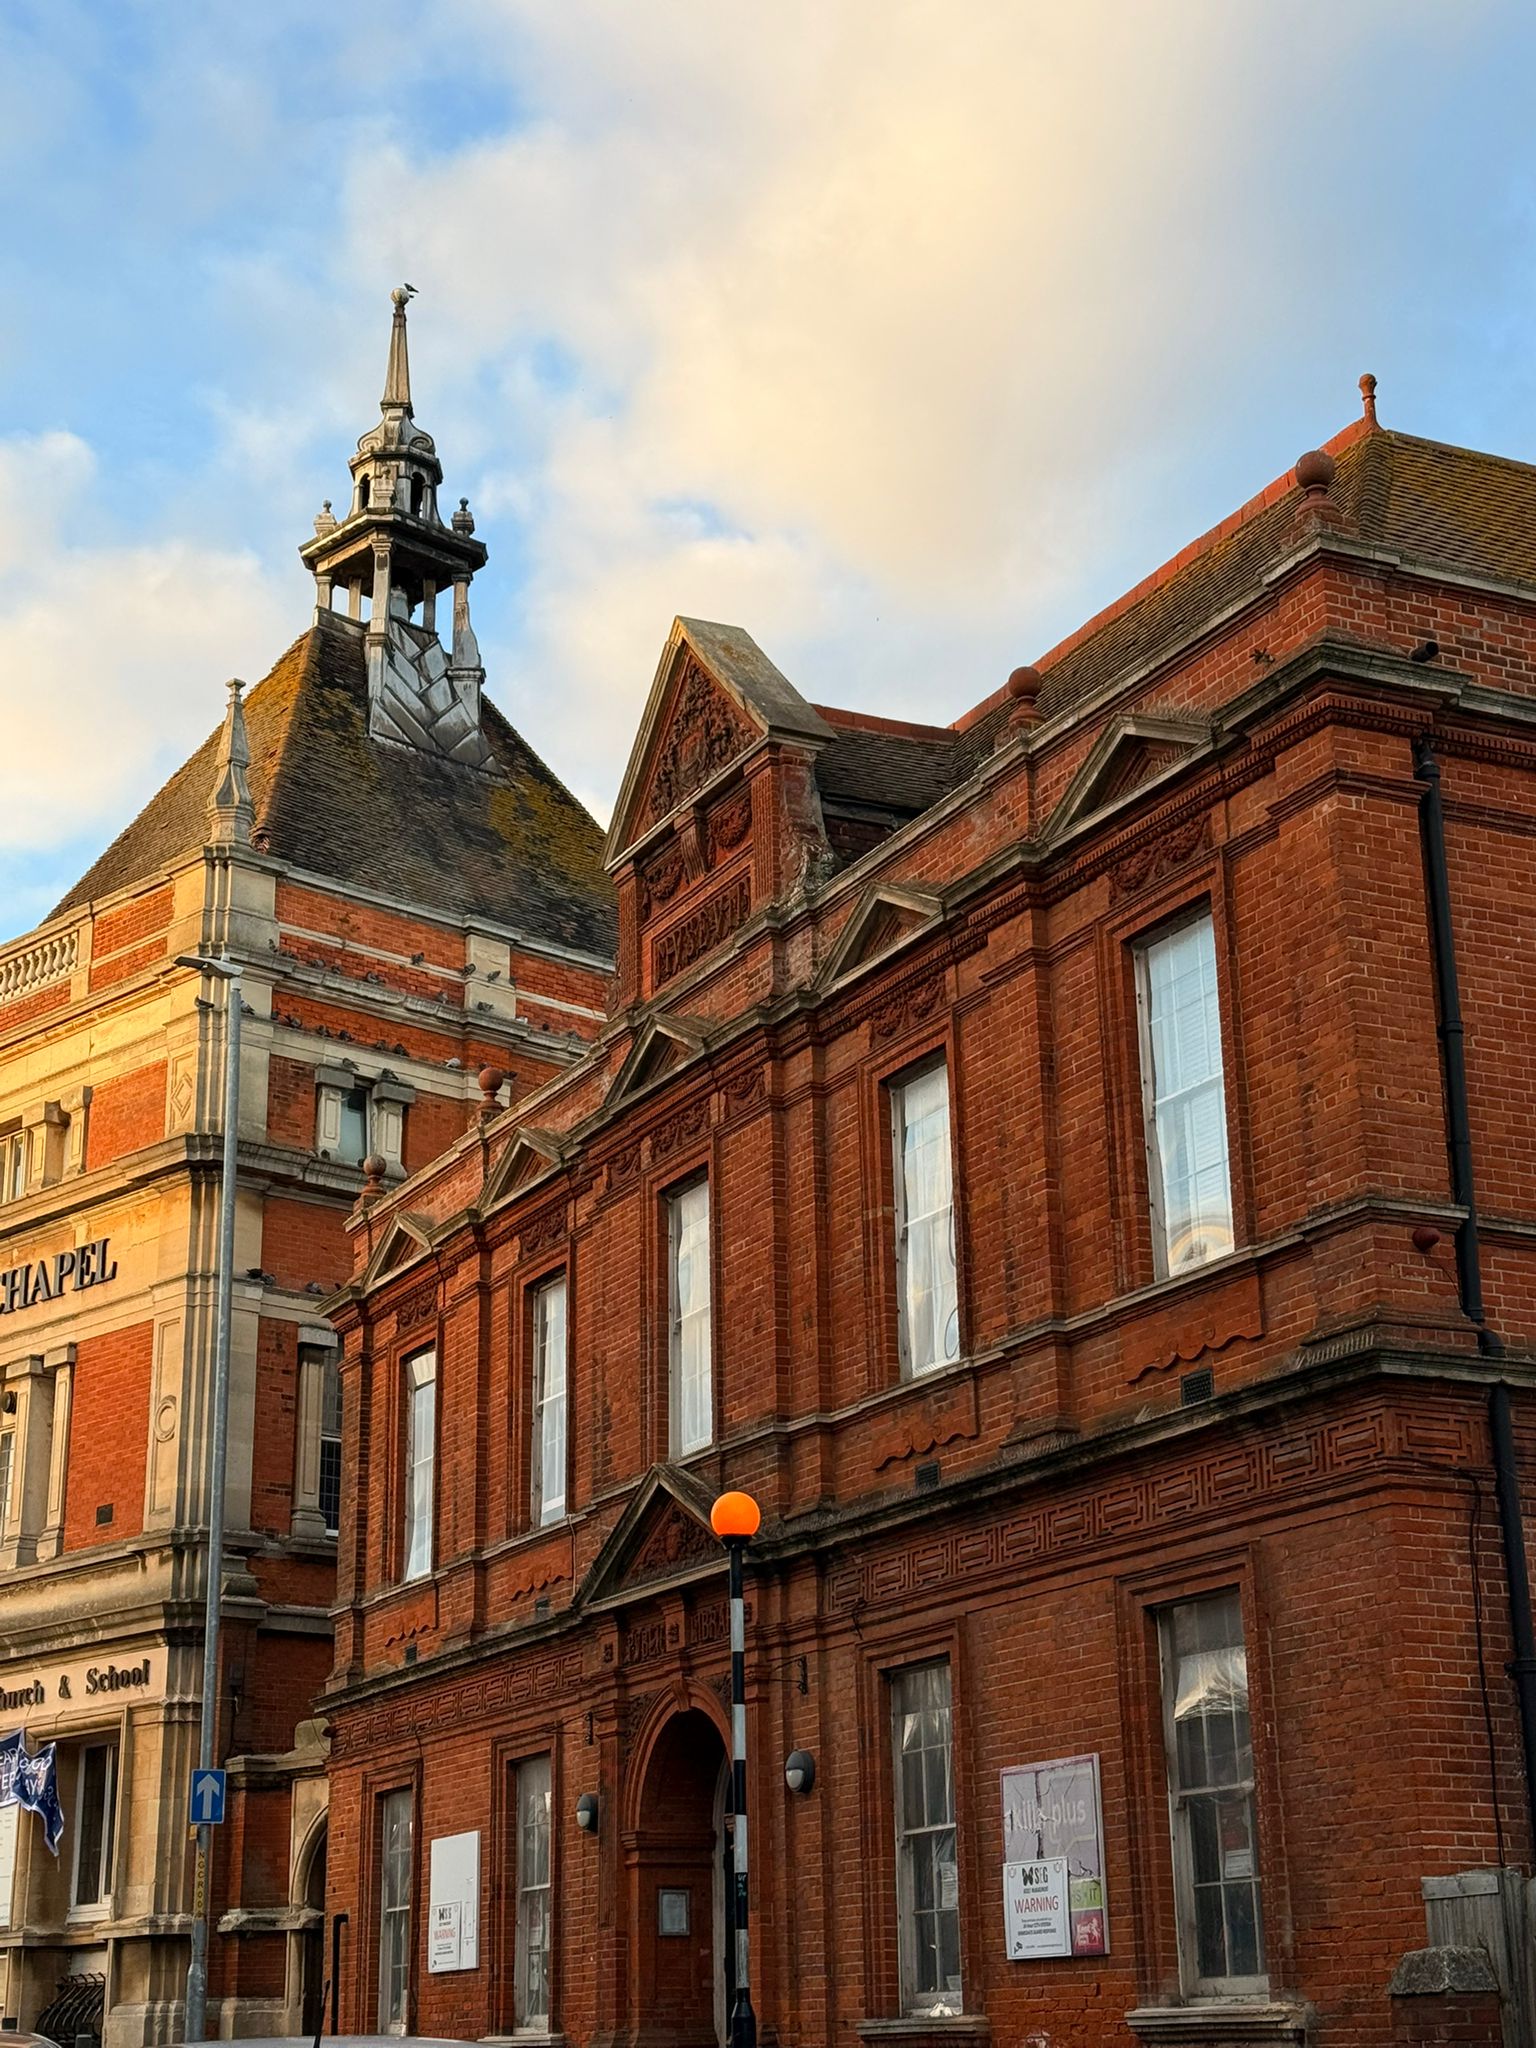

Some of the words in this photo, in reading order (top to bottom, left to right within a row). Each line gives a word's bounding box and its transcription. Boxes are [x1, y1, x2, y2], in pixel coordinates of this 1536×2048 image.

[0, 1238, 118, 1315] HAPEL
[58, 1674, 72, 1699] &
[85, 1658, 151, 1695] School
[1014, 1895, 1060, 1914] WARNING
